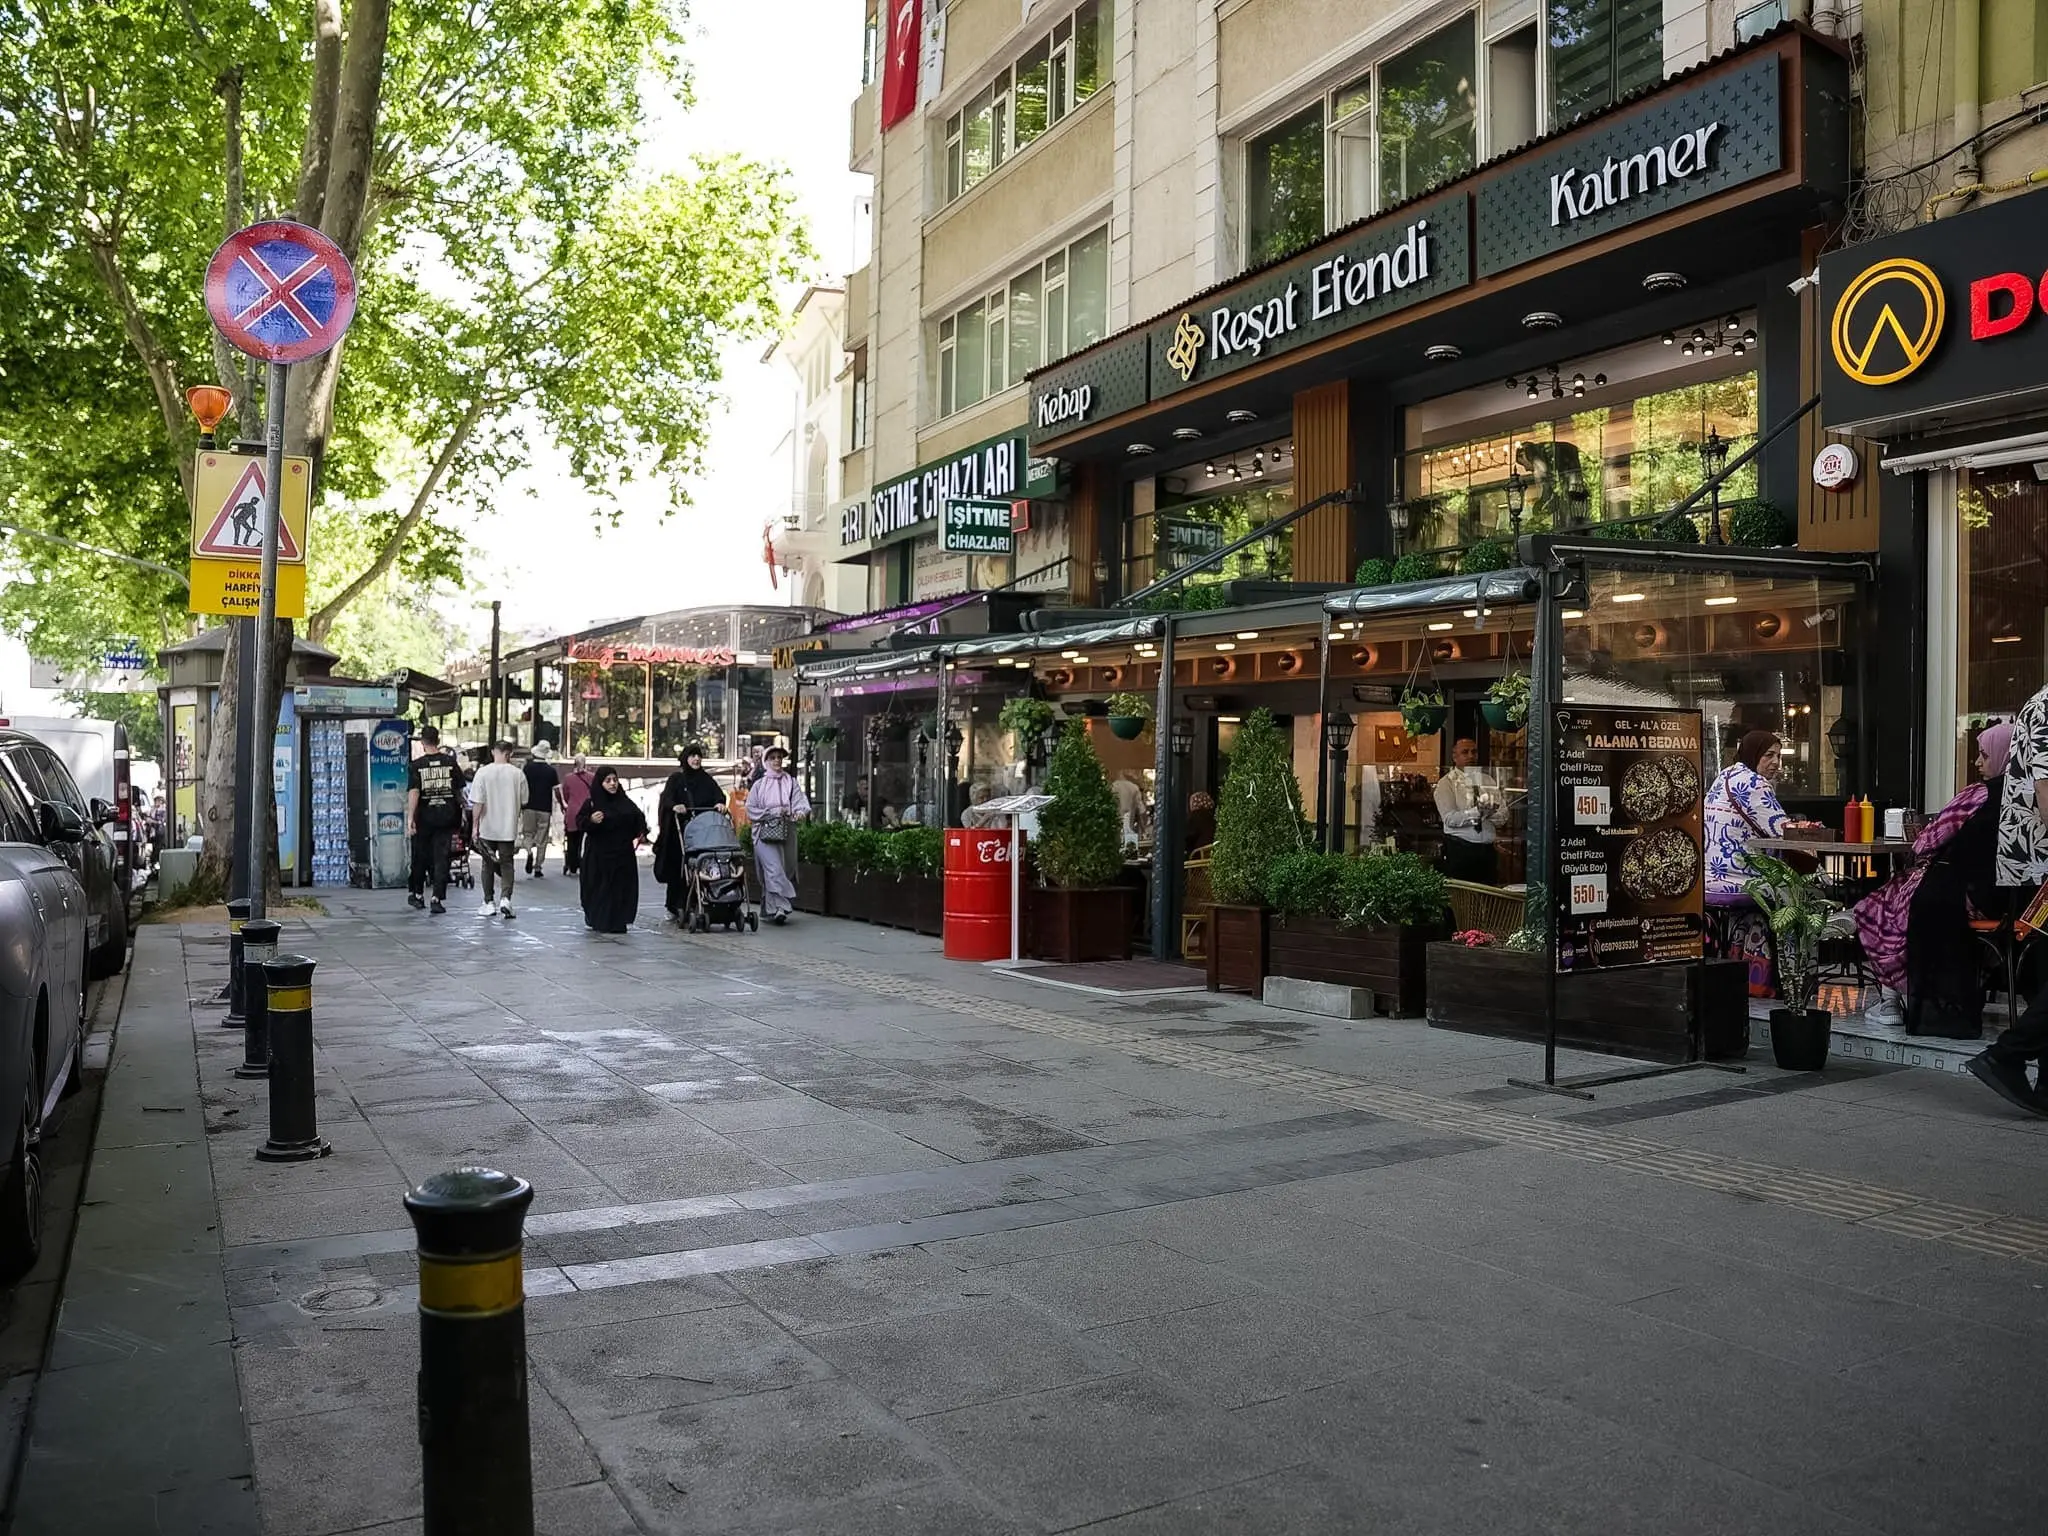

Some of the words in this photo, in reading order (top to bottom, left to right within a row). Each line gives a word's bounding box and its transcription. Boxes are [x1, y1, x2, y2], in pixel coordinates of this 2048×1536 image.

[1551, 121, 1718, 227] Katmer
[1211, 281, 1298, 358] Reşat
[1312, 219, 1429, 321] Efendi
[1038, 384, 1091, 428] Kebap
[840, 502, 863, 545] ARI
[871, 476, 920, 540] İŞİTME
[947, 501, 1010, 529] İŞİTME
[947, 531, 1010, 551] CİHAZLARI
[228, 569, 260, 579] DİKKA
[224, 582, 260, 593] HARFİY
[221, 596, 260, 609] ÇALIŞM
[1615, 720, 1632, 730] GEL
[1660, 719, 1682, 731] ÖZEL
[1585, 734, 1593, 748] 1
[1594, 734, 1640, 749] ALANA
[1640, 735, 1648, 748] 1
[1648, 736, 1698, 750] BEDAVA
[1559, 750, 1566, 759] 2
[1566, 750, 1586, 759] Adet
[1583, 763, 1604, 773] Pizza
[1577, 795, 1598, 815] 450
[1560, 838, 1567, 847] 2
[1567, 837, 1587, 847] Adet
[1584, 850, 1605, 860] Pizza
[1573, 884, 1595, 904] 550
